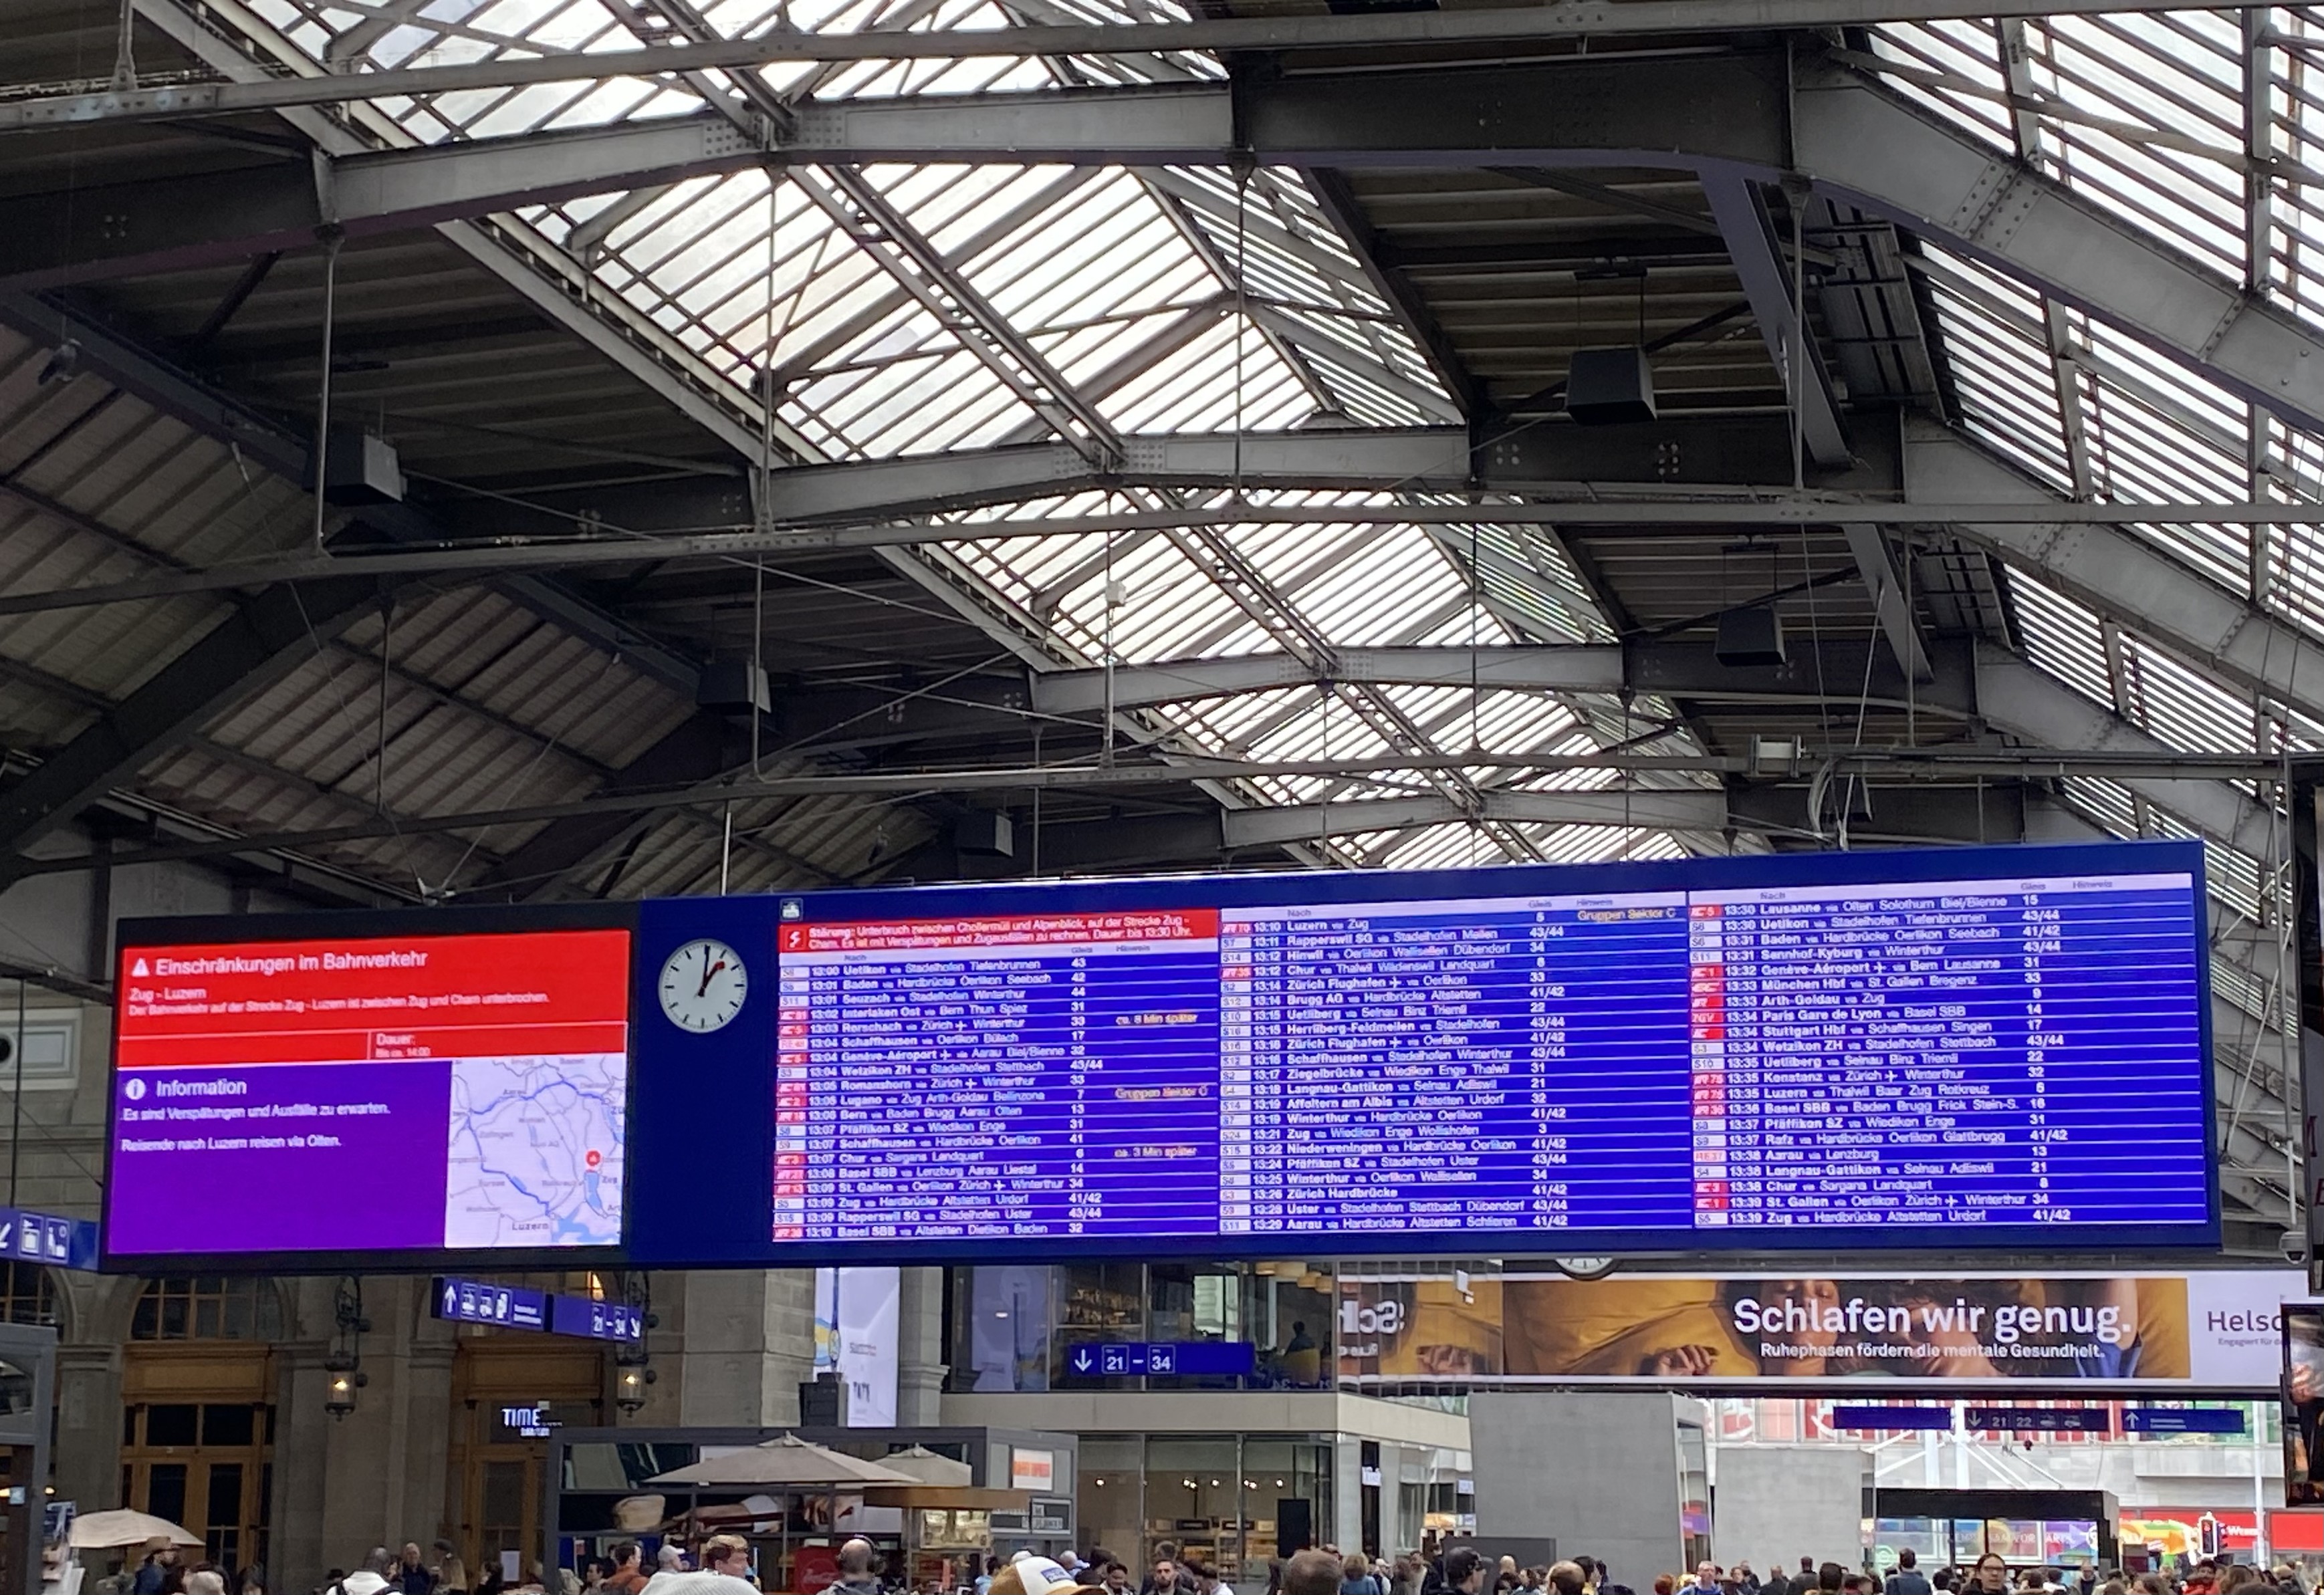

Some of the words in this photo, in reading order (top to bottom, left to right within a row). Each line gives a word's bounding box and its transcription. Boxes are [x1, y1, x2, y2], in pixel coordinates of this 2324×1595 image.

[1760, 904, 1821, 914] Lausanne
[2022, 895, 2038, 906] 15
[1287, 921, 1327, 932] Luzern
[1348, 918, 1369, 931] Zug
[1530, 926, 1564, 939] 43/44
[156, 957, 294, 976] Einschränkungen
[299, 954, 319, 970] im
[324, 951, 428, 969] Bahnverkehr
[1071, 958, 1086, 968] 43
[1287, 965, 1316, 975] Chur
[1762, 977, 1819, 989] München
[2024, 972, 2041, 983] 33
[1862, 993, 1885, 1005] Zug
[1071, 1001, 1085, 1012] 31
[1072, 1031, 1084, 1041] 17
[1531, 1064, 1545, 1073] 31
[156, 1078, 247, 1097] Information
[2032, 1146, 2047, 1156] 13
[1733, 1298, 1912, 1333] Schlafen
[1922, 1299, 1989, 1332] wir
[1994, 1304, 2131, 1343] genug.
[1762, 1343, 1854, 1360] Ruhephasen
[1856, 1342, 1911, 1358] fördern
[1917, 1343, 1940, 1358] die
[1943, 1343, 2007, 1358] mentale
[2010, 1342, 2105, 1359] Gesundheit.
[1107, 1356, 1123, 1370] 21
[1152, 1356, 1170, 1370] 34
[501, 1408, 542, 1427] TIME
[1992, 1417, 2006, 1427] 21
[2016, 1417, 2032, 1427] 22
